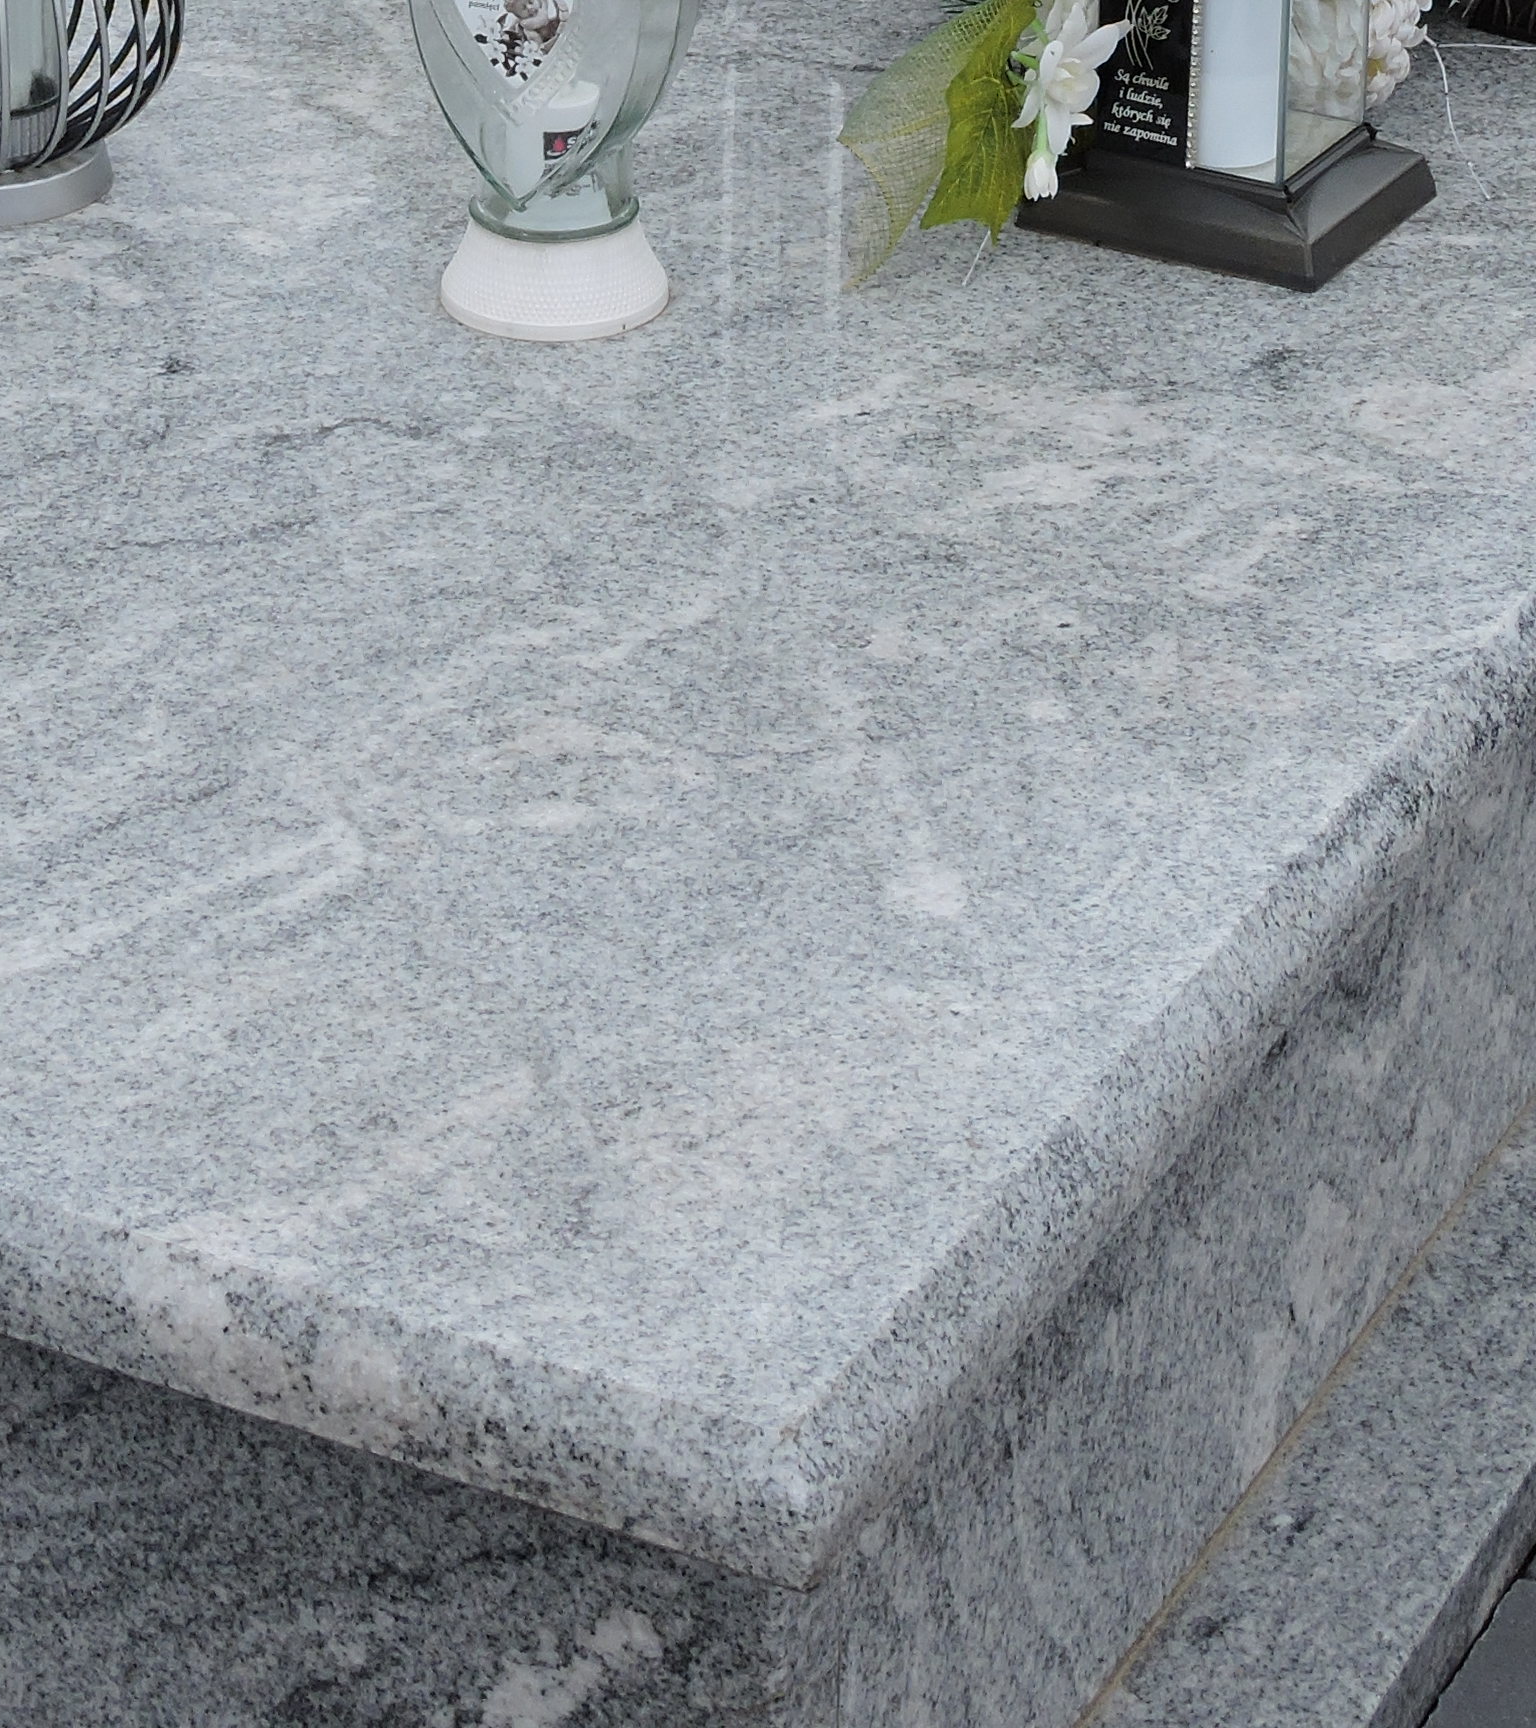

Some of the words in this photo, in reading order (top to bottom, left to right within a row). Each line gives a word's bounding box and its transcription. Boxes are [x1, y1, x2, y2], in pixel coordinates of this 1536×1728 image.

[1114, 68, 1131, 85] Są
[1132, 71, 1170, 91] chwile
[1119, 86, 1125, 99] i
[1126, 87, 1163, 110] ludzie,
[1111, 101, 1154, 123] których
[1156, 113, 1172, 130] się
[1104, 120, 1121, 133] nie
[1123, 125, 1178, 147] zapomina
